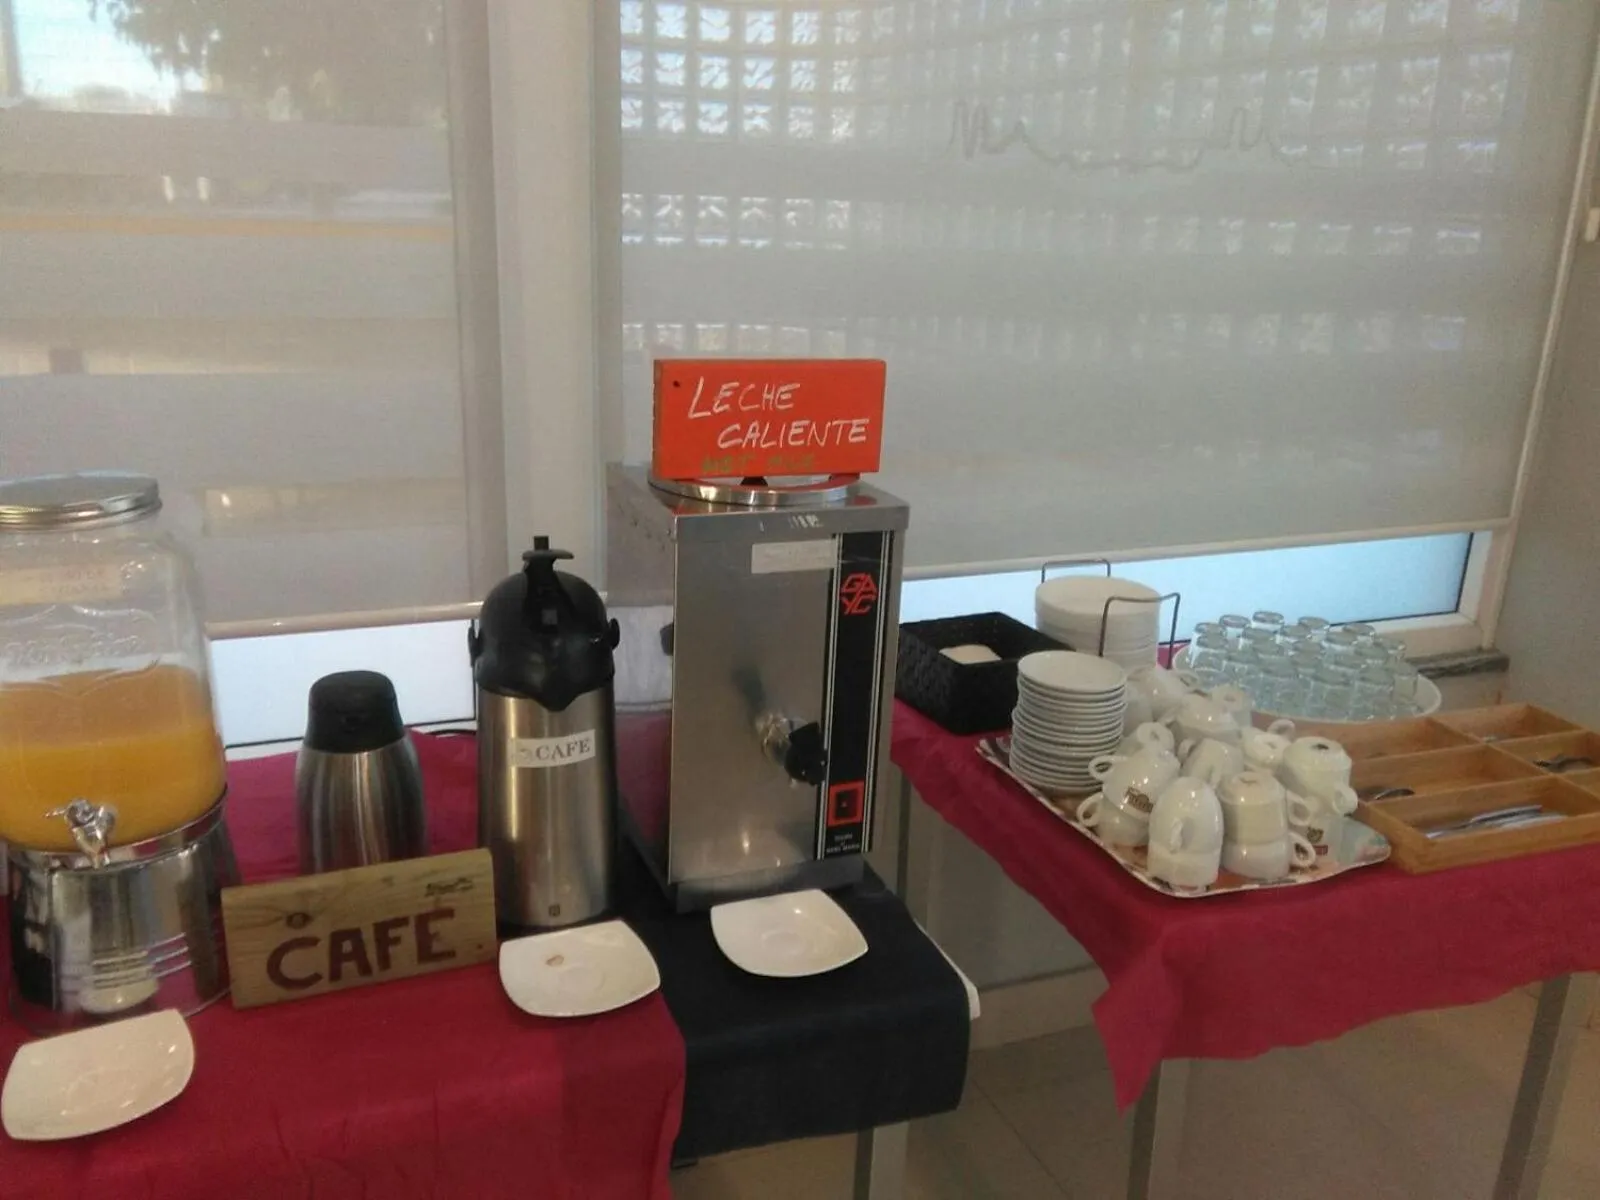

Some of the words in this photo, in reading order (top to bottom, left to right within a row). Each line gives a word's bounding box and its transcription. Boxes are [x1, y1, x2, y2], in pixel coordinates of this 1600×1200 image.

[687, 376, 800, 419] LECHE
[717, 418, 870, 449] CALIENTE
[535, 738, 590, 761] CAFE
[266, 907, 457, 990] CAFE
